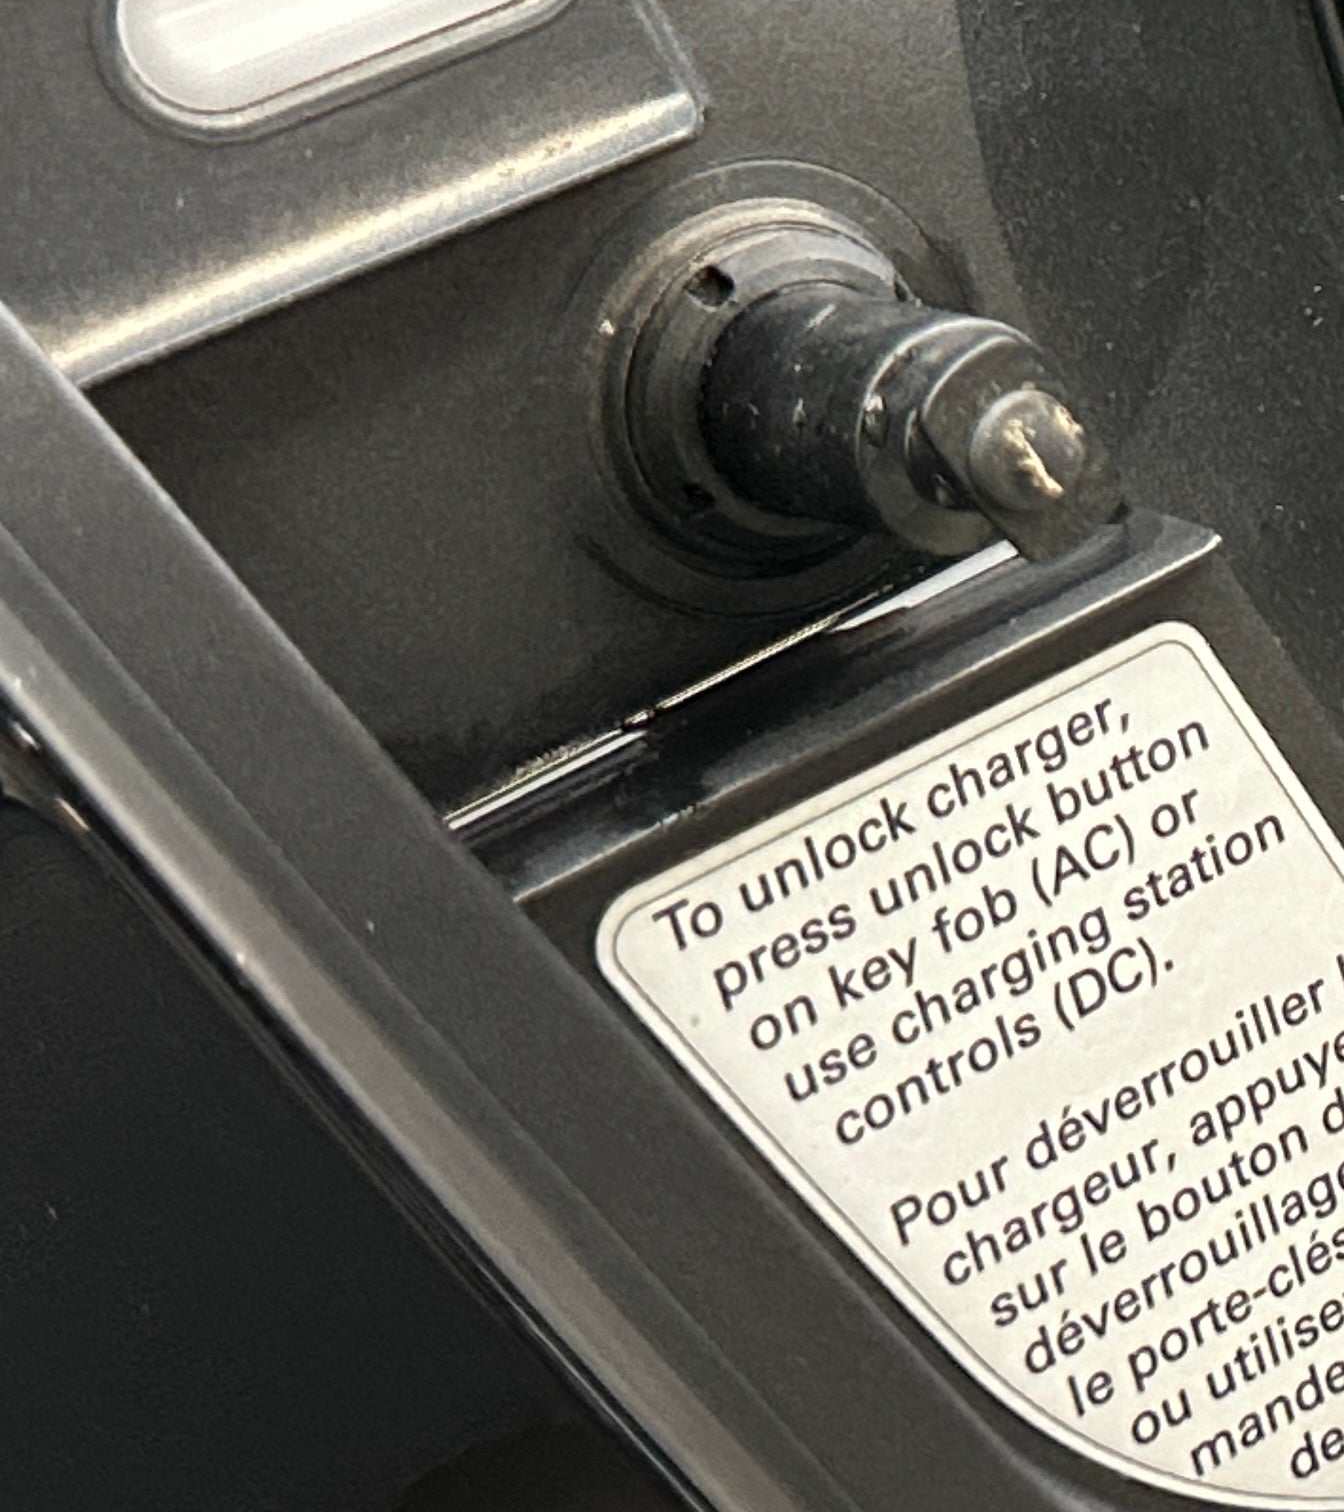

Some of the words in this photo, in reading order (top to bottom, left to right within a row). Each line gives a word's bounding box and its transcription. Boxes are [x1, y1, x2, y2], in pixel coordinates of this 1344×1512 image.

[652, 899, 723, 951] To
[739, 798, 916, 913] unlock
[927, 698, 1129, 818] charger,
[713, 904, 856, 1012] press
[869, 804, 1040, 916] unlock
[1046, 722, 1209, 825] button
[750, 995, 817, 1050] on
[828, 937, 916, 1010] key
[932, 885, 1017, 953] fob
[1032, 814, 1134, 908] (AC)
[1151, 789, 1198, 838] or
[784, 1033, 877, 1102] use
[892, 906, 1111, 1045] charging
[1124, 815, 1285, 921] station
[836, 1013, 1041, 1145] controls
[1054, 937, 1174, 1032] (DC).
[890, 1155, 1008, 1247] Pour
[1026, 979, 1324, 1170] déverrouiller
[944, 1139, 1176, 1285] chargeur,
[991, 1259, 1067, 1327] sur
[1080, 1230, 1127, 1276] le
[1137, 1125, 1308, 1242] bouton
[1067, 1374, 1114, 1418] le
[1131, 1389, 1192, 1445] ou
